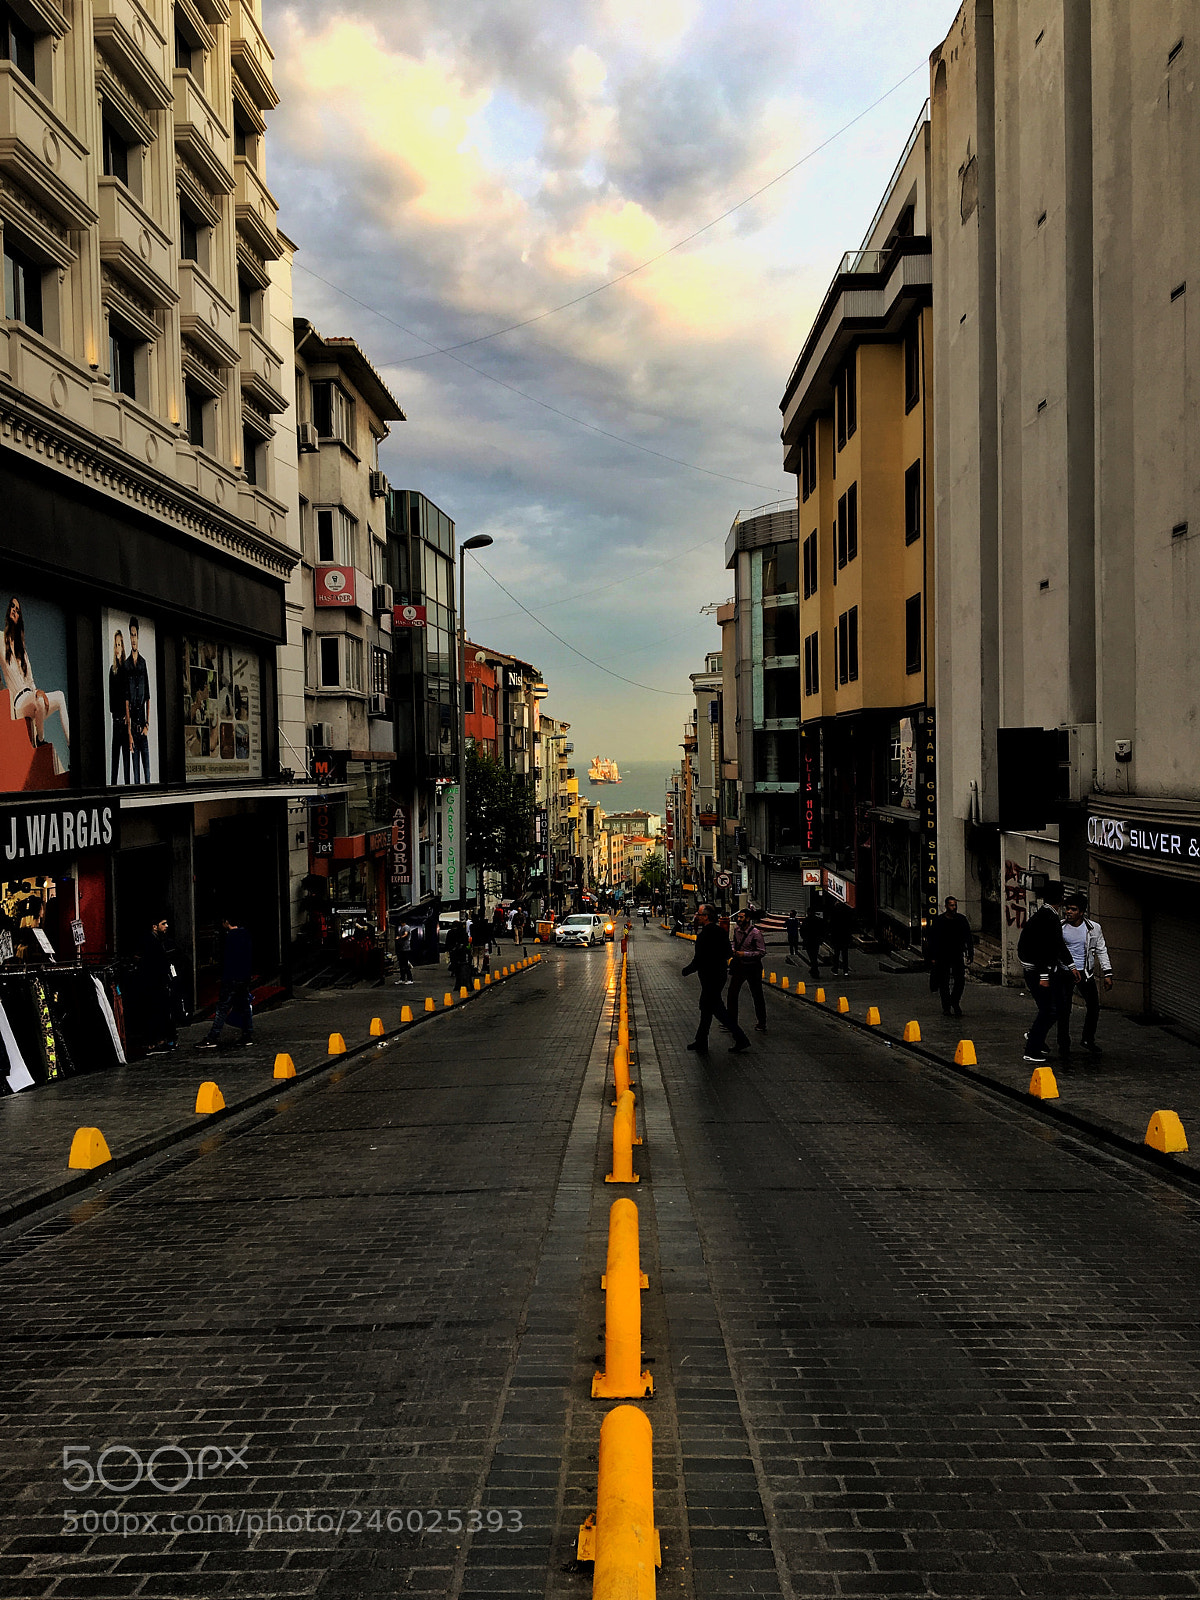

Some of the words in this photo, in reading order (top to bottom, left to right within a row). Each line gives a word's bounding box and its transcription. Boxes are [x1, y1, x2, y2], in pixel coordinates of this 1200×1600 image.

[926, 716, 934, 763] STAR
[446, 796, 455, 842] GARBY
[805, 800, 813, 850] HOTEL
[926, 782, 936, 829] GOLD
[5, 807, 113, 861] J.WARGAS
[393, 808, 407, 875] ACCORD
[1130, 829, 1182, 855] SILVER
[447, 847, 456, 894] SHOES
[928, 841, 936, 884] STAR
